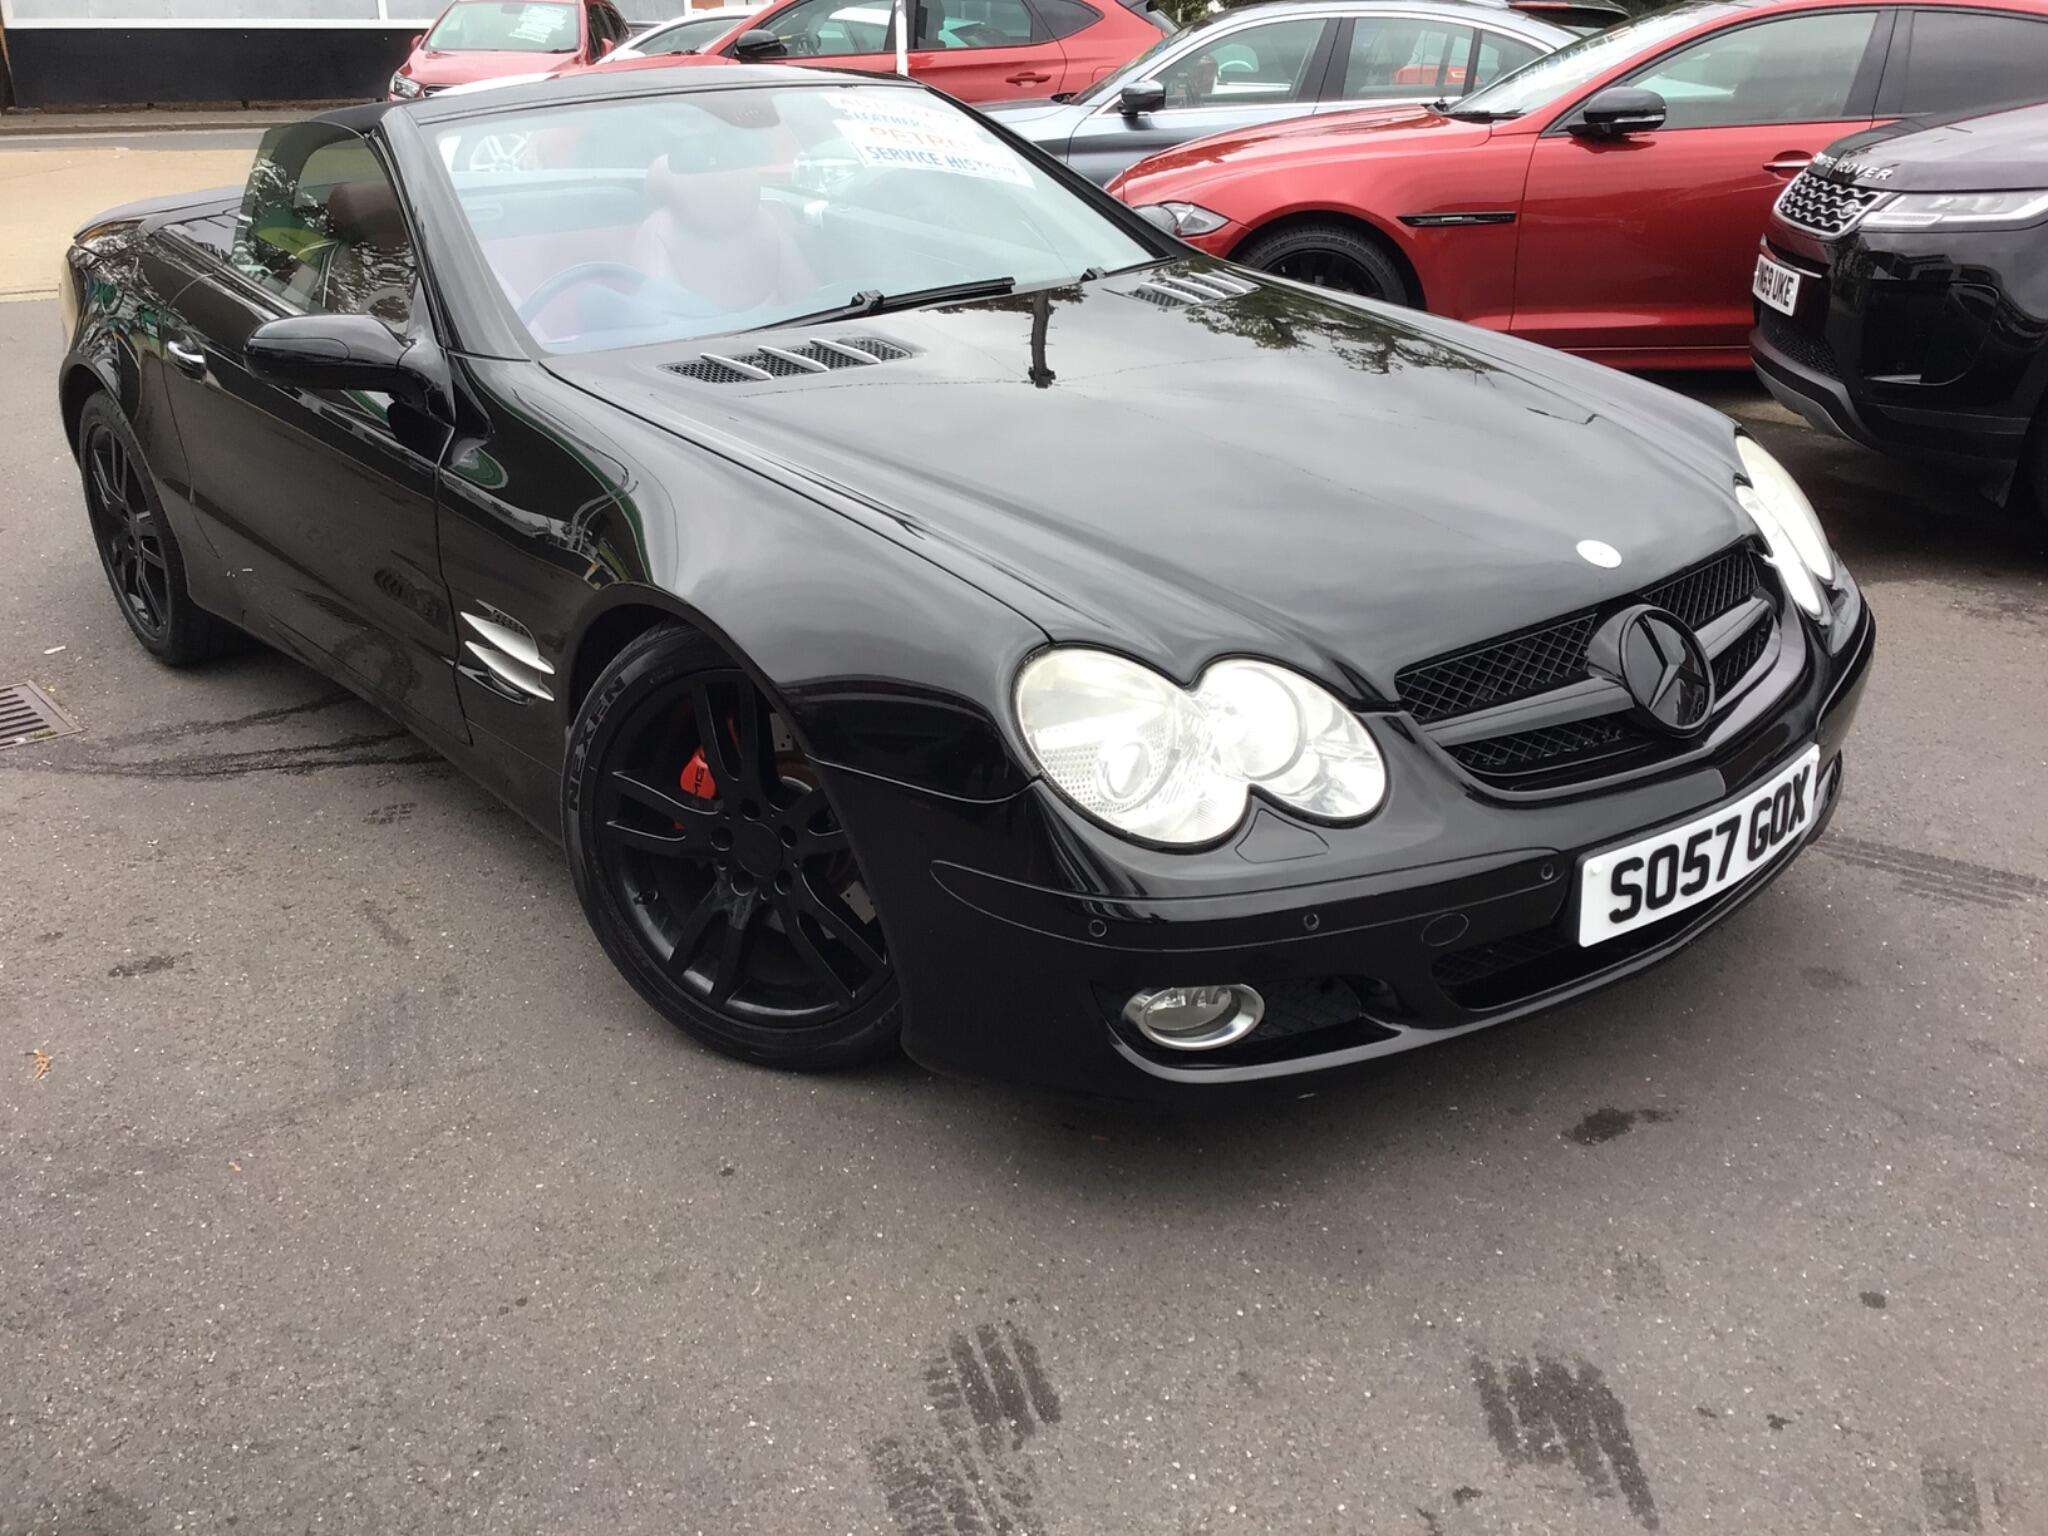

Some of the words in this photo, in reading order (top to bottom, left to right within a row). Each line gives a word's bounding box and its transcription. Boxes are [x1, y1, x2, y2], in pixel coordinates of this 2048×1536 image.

[865, 145, 943, 166] SERVICE
[1838, 160, 1893, 181] ROVER
[1772, 269, 1794, 307] UKE
[567, 674, 626, 811] NEXEN
[1608, 814, 1742, 924] SO57
[1747, 764, 1811, 862] GOX
